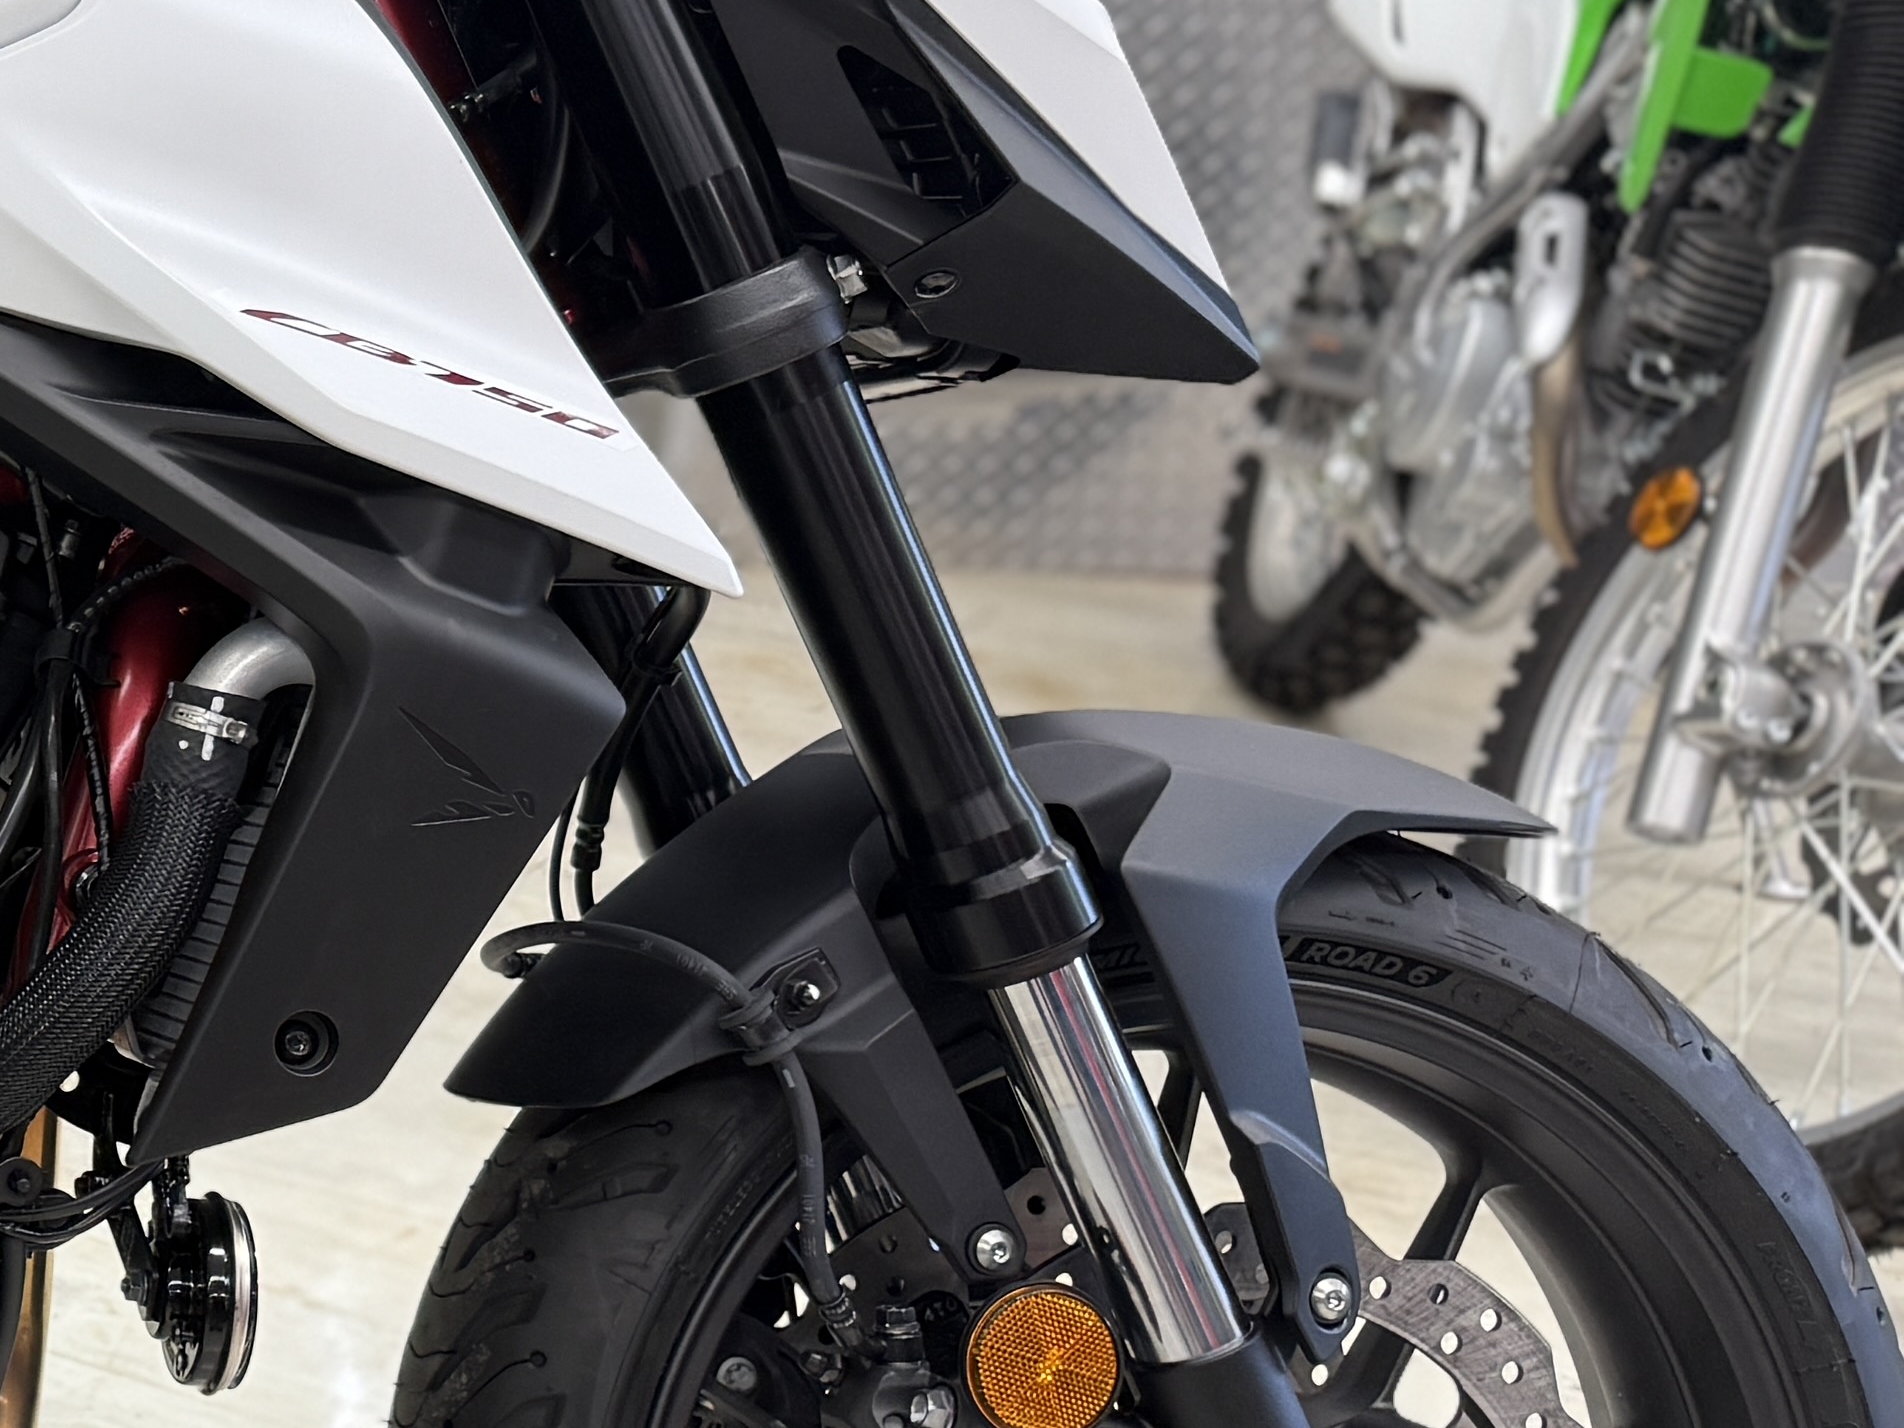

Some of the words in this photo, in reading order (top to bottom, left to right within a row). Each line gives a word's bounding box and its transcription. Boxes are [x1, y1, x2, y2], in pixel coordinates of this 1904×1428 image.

[240, 308, 619, 439] CB750
[1303, 943, 1402, 977] ROAD
[1408, 965, 1437, 986] 6
